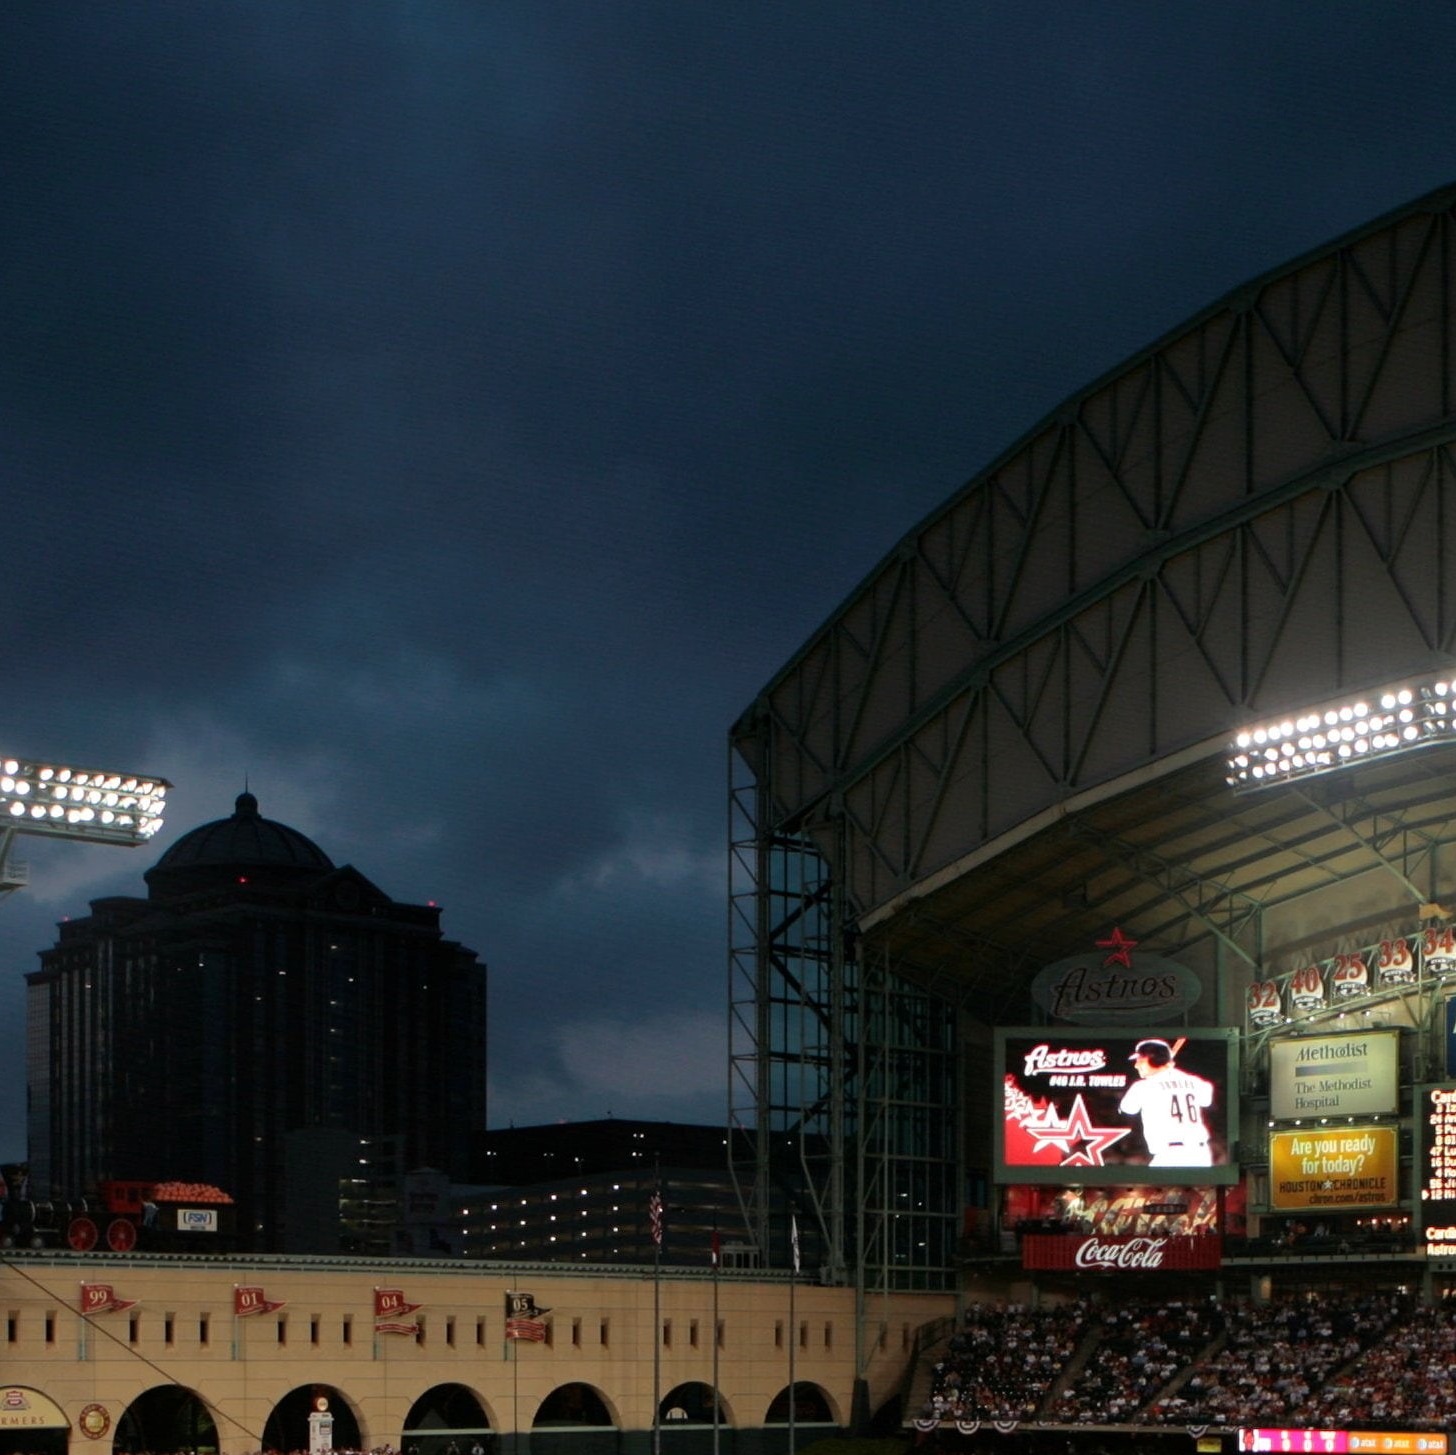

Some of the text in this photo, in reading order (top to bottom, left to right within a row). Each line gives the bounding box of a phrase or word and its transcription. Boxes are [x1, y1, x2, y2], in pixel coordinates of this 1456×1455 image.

[1422, 927, 1455, 956] 34
[1377, 938, 1408, 968] 33
[1333, 952, 1363, 980] 25
[1290, 966, 1321, 994] 40
[1053, 967, 1178, 1016] Astros
[1248, 981, 1278, 1009] 32
[1024, 1044, 1107, 1077] Astros
[1296, 1043, 1368, 1062] Methodist
[1089, 1075, 1127, 1088] TOWLES
[1295, 1078, 1373, 1095] The Methodist
[1170, 1094, 1198, 1124] 46
[1295, 1096, 1340, 1111] Hospital
[1291, 1134, 1376, 1158] Are you ready
[1302, 1154, 1366, 1176] for today?
[1279, 1177, 1386, 1194] HOUSTON CHRONICLE
[187, 1212, 208, 1224] FSN
[88, 1289, 108, 1305] 99
[240, 1292, 258, 1307] 01
[381, 1295, 398, 1309] 04
[512, 1298, 529, 1312] 05
